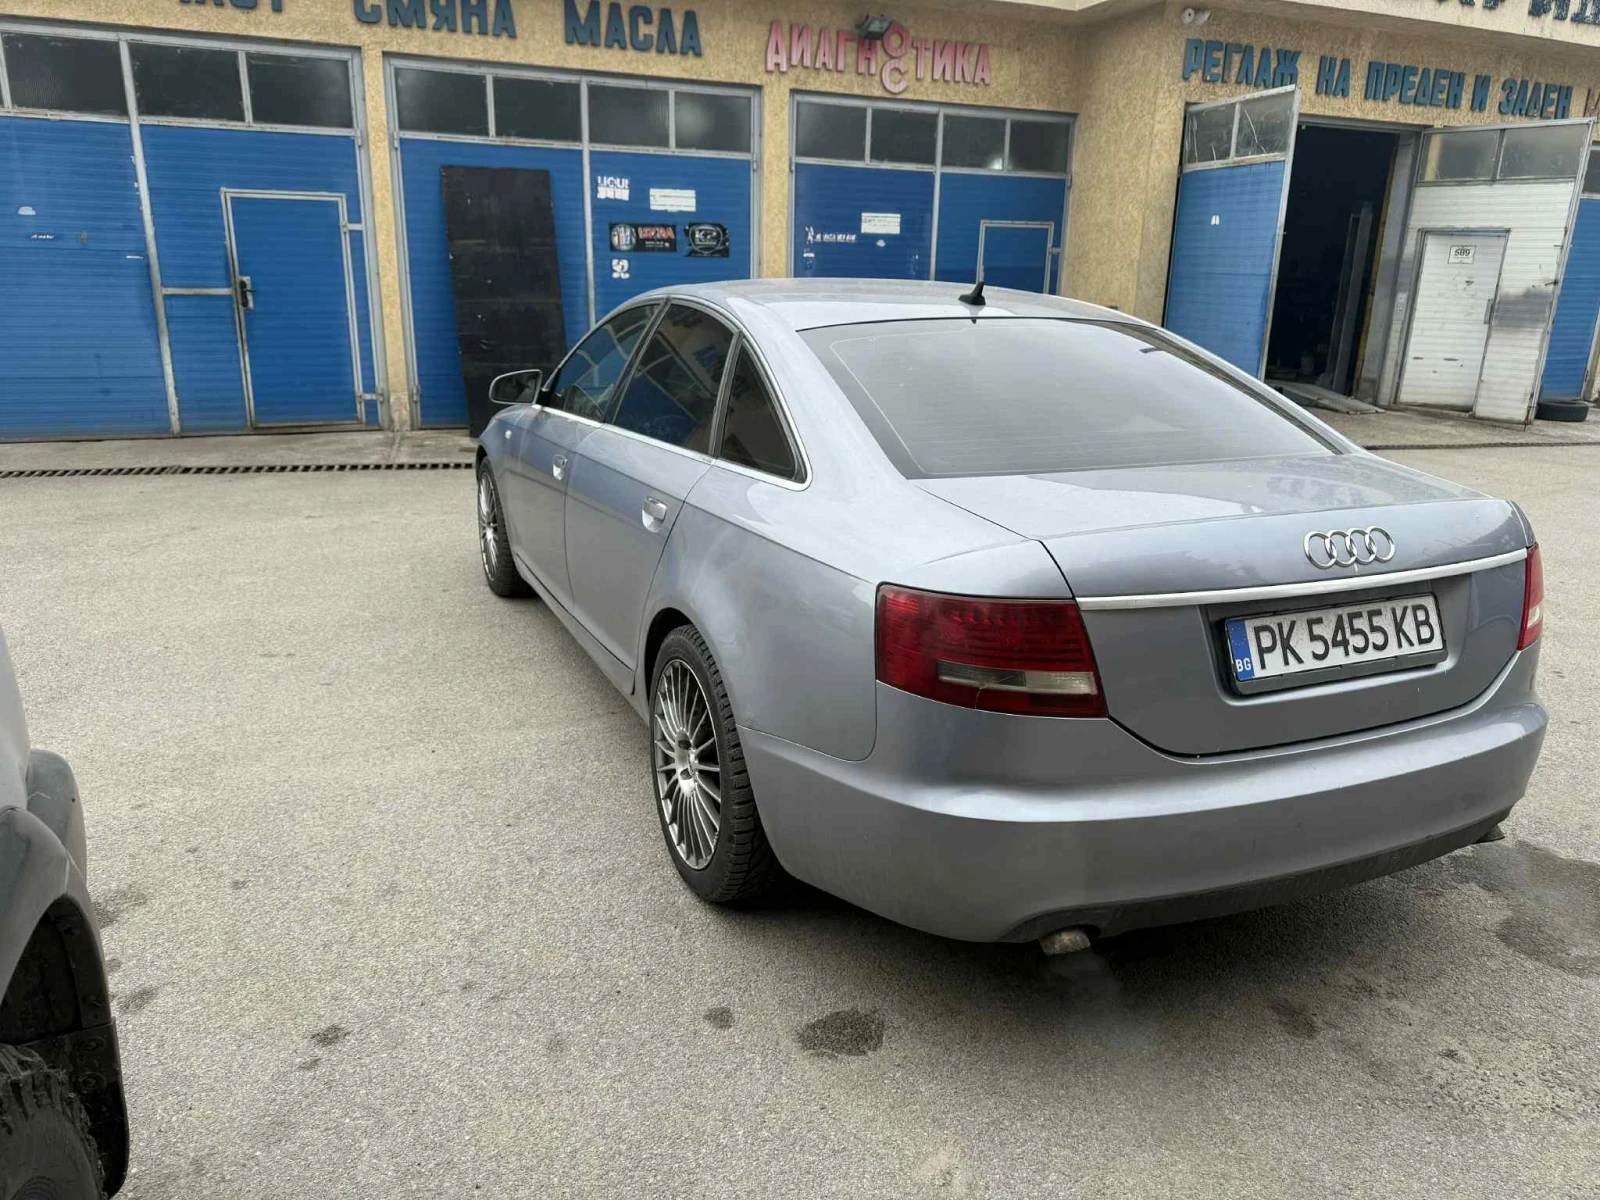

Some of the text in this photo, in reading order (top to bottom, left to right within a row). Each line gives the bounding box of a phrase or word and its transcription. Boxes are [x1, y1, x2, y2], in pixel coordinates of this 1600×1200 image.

[564, 0, 702, 56] МАСЛА
[1183, 38, 1301, 88] РЕГЛАЖ
[1315, 55, 1351, 97] НА
[1364, 61, 1466, 109] ПРЕДЕН
[1471, 74, 1491, 112] И
[1498, 77, 1573, 119] ЗАДЕН
[597, 175, 629, 189] LIQUI
[1253, 603, 1435, 670] PK 5455 KB
[1235, 658, 1252, 673] BG
